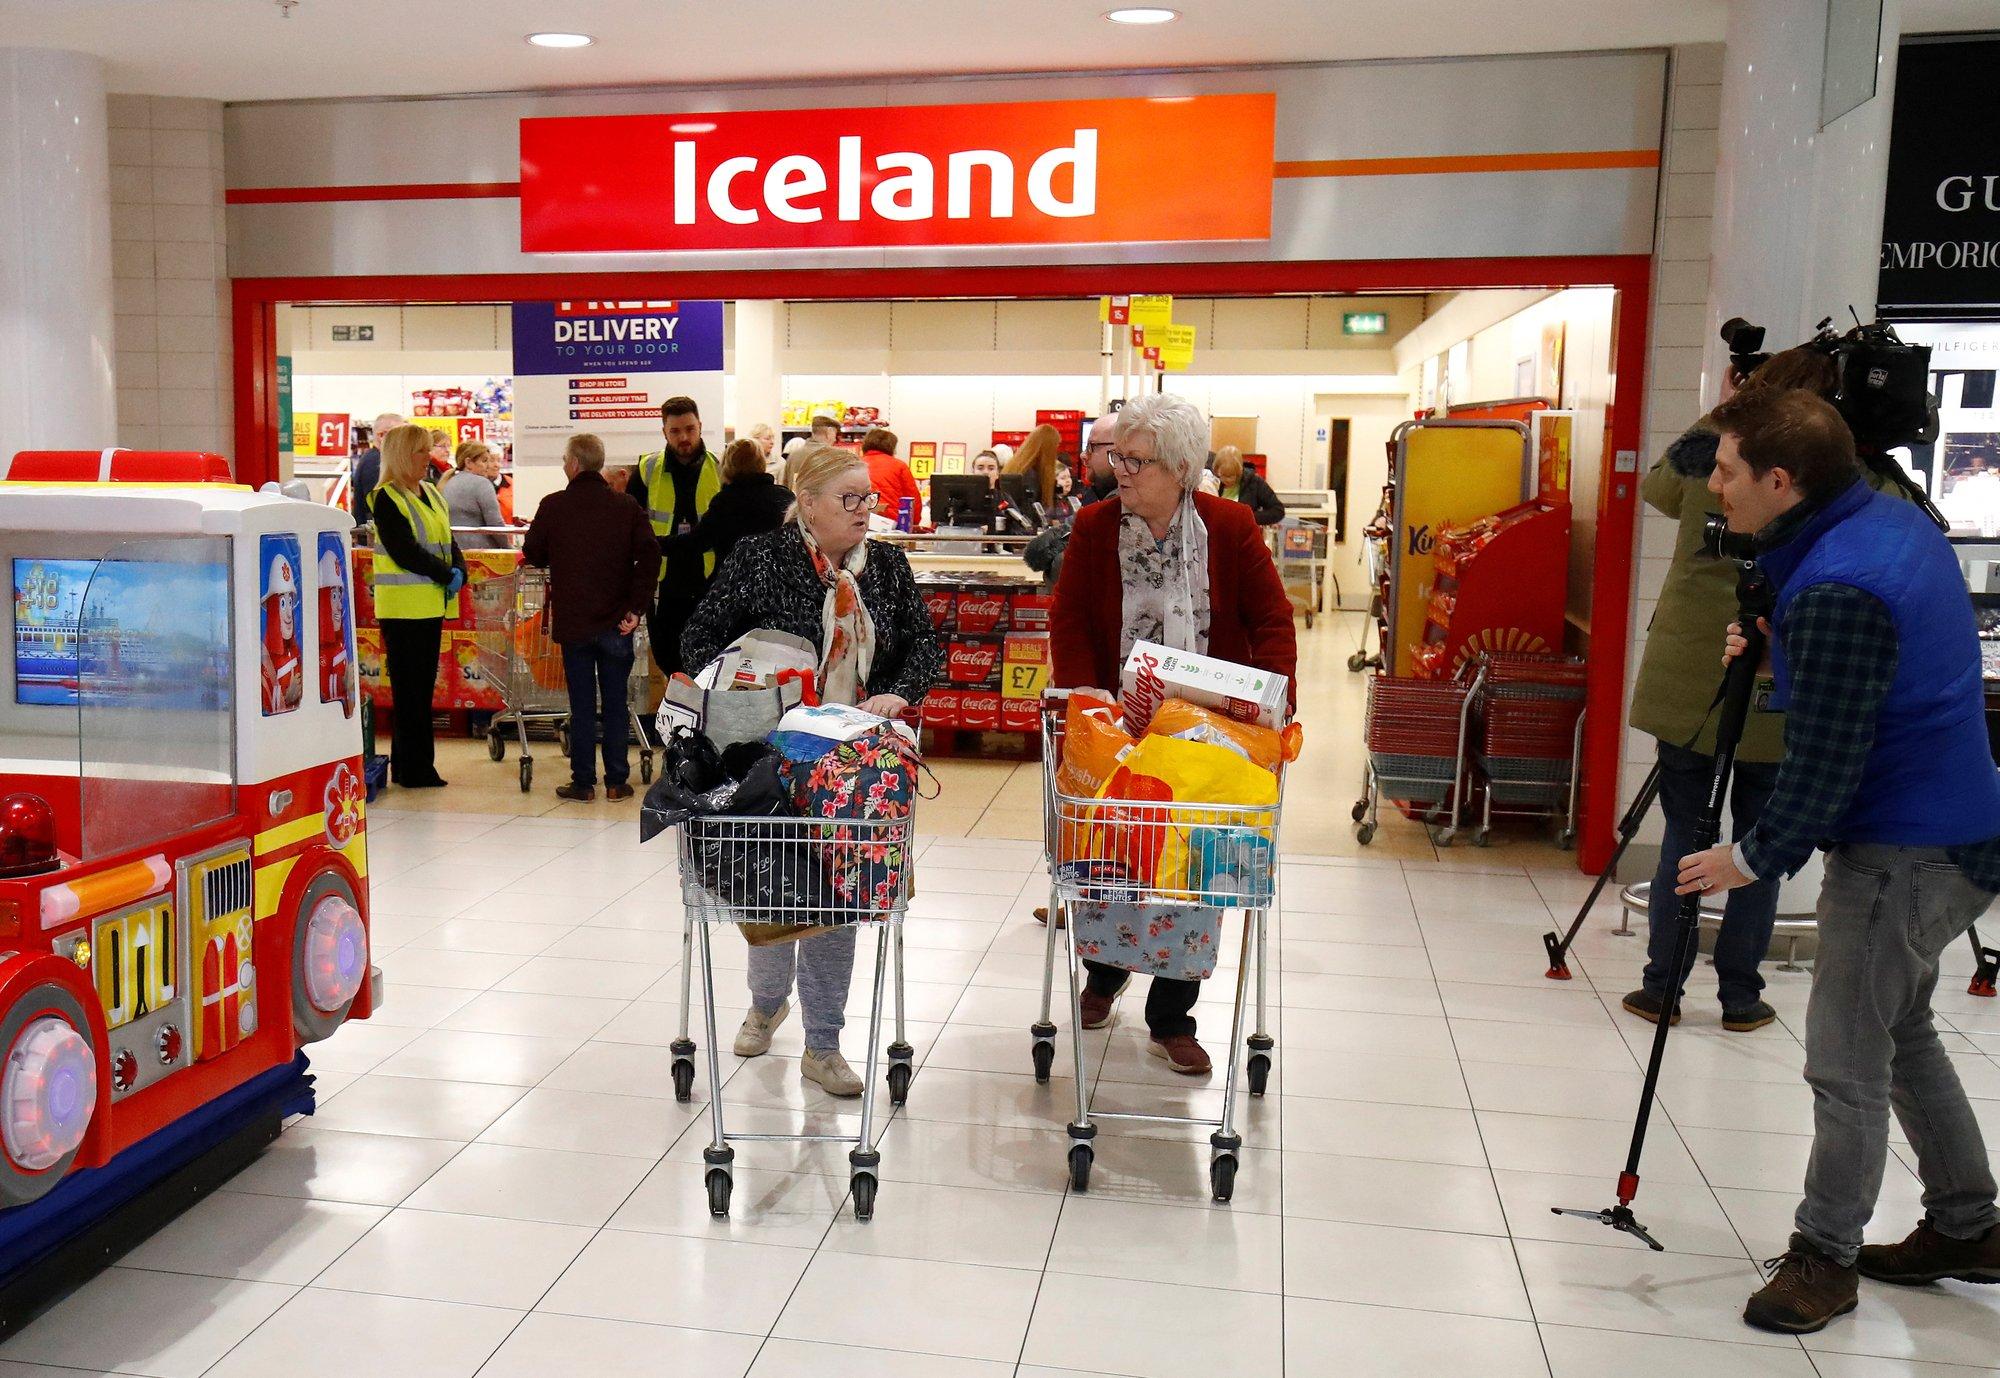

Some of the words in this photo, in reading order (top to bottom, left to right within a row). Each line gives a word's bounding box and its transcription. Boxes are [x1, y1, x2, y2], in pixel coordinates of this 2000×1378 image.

[672, 128, 1098, 226] Iceland
[554, 317, 679, 342] DELIVERY
[556, 346, 575, 356] TO
[585, 344, 625, 355] YOUR
[635, 343, 679, 354] DOOR
[320, 421, 345, 447] £1
[460, 424, 480, 442] £1
[916, 459, 930, 473] £1
[947, 458, 959, 469] £1
[1162, 656, 1174, 671] CORN
[1012, 666, 1038, 689] £7
